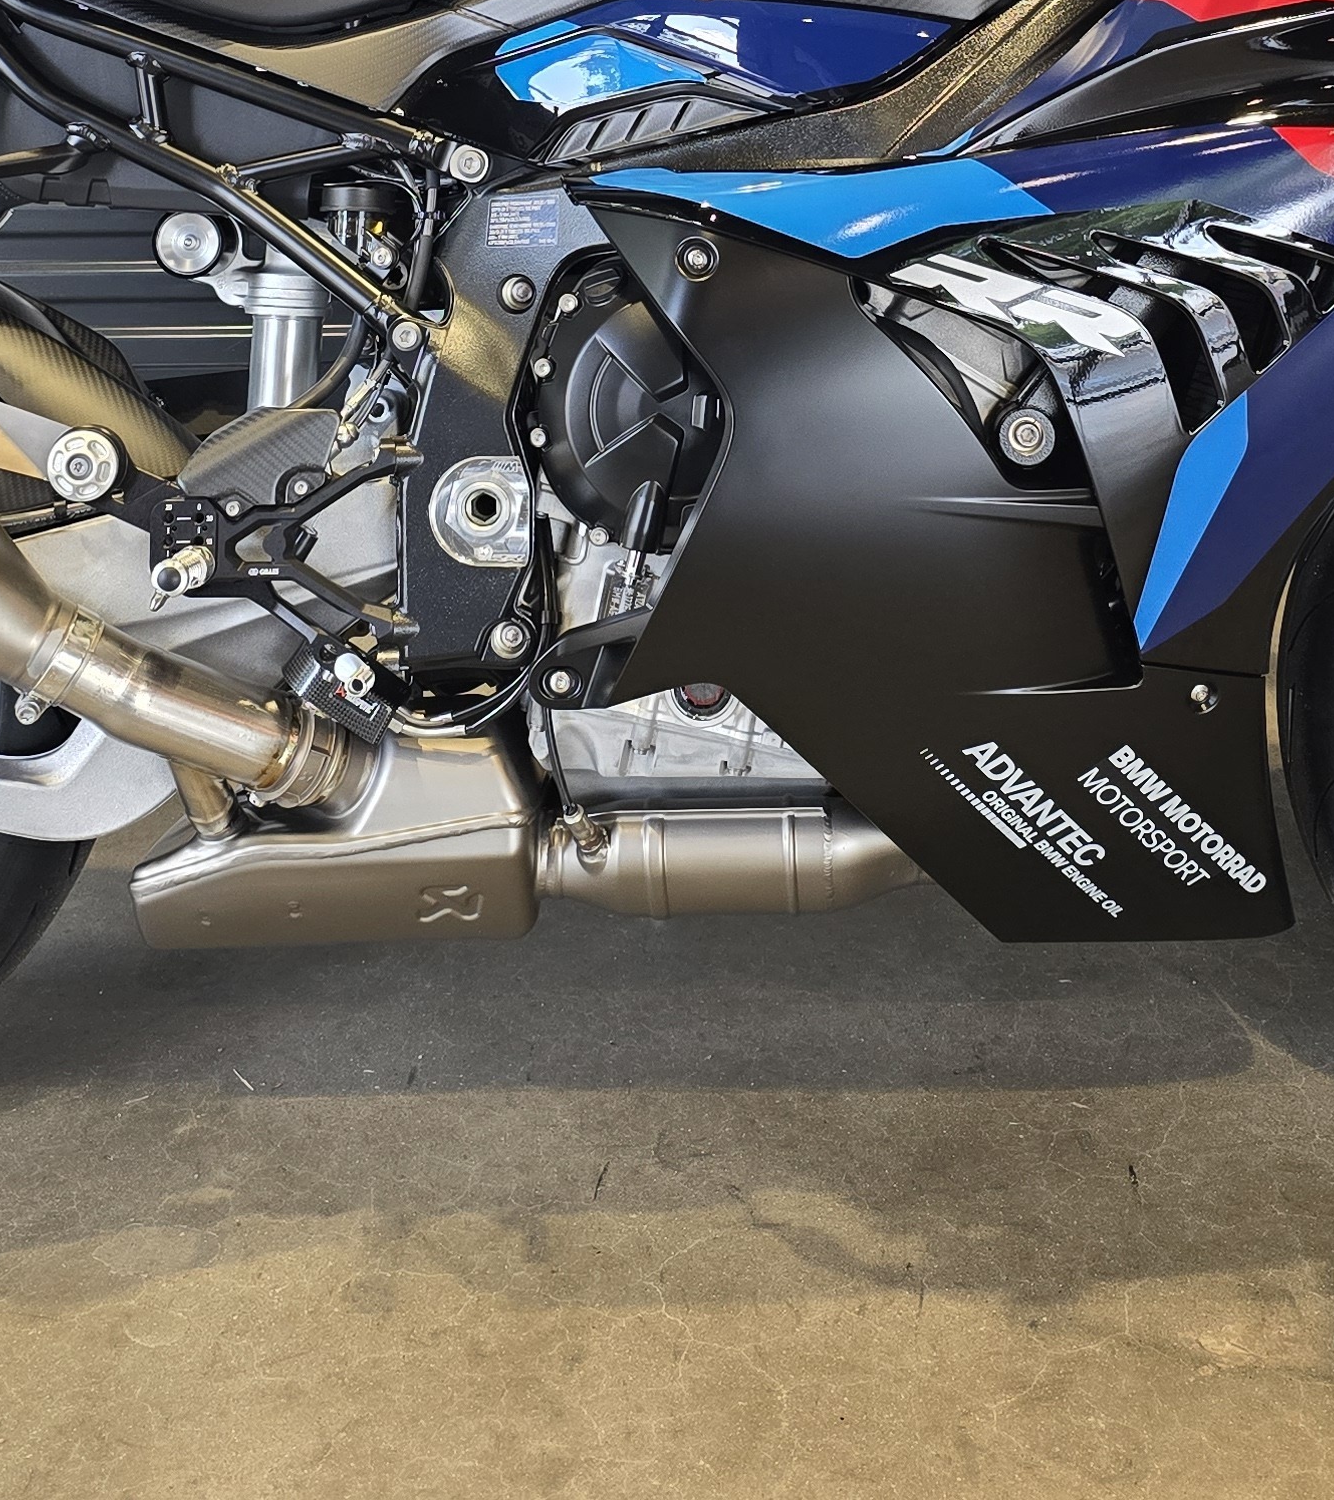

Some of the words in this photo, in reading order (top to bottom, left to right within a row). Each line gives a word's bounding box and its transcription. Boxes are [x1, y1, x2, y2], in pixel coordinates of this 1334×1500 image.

[962, 741, 1106, 867] ADVANTEC
[981, 790, 1038, 845] ORIGINAL
[1034, 838, 1068, 870] BMW
[1061, 864, 1108, 904] ENGINE
[1101, 899, 1124, 918] OIL
[1077, 767, 1211, 888] MOTORSPORT
[1108, 744, 1173, 802] BMW
[1158, 794, 1267, 894] MOTORRAD
